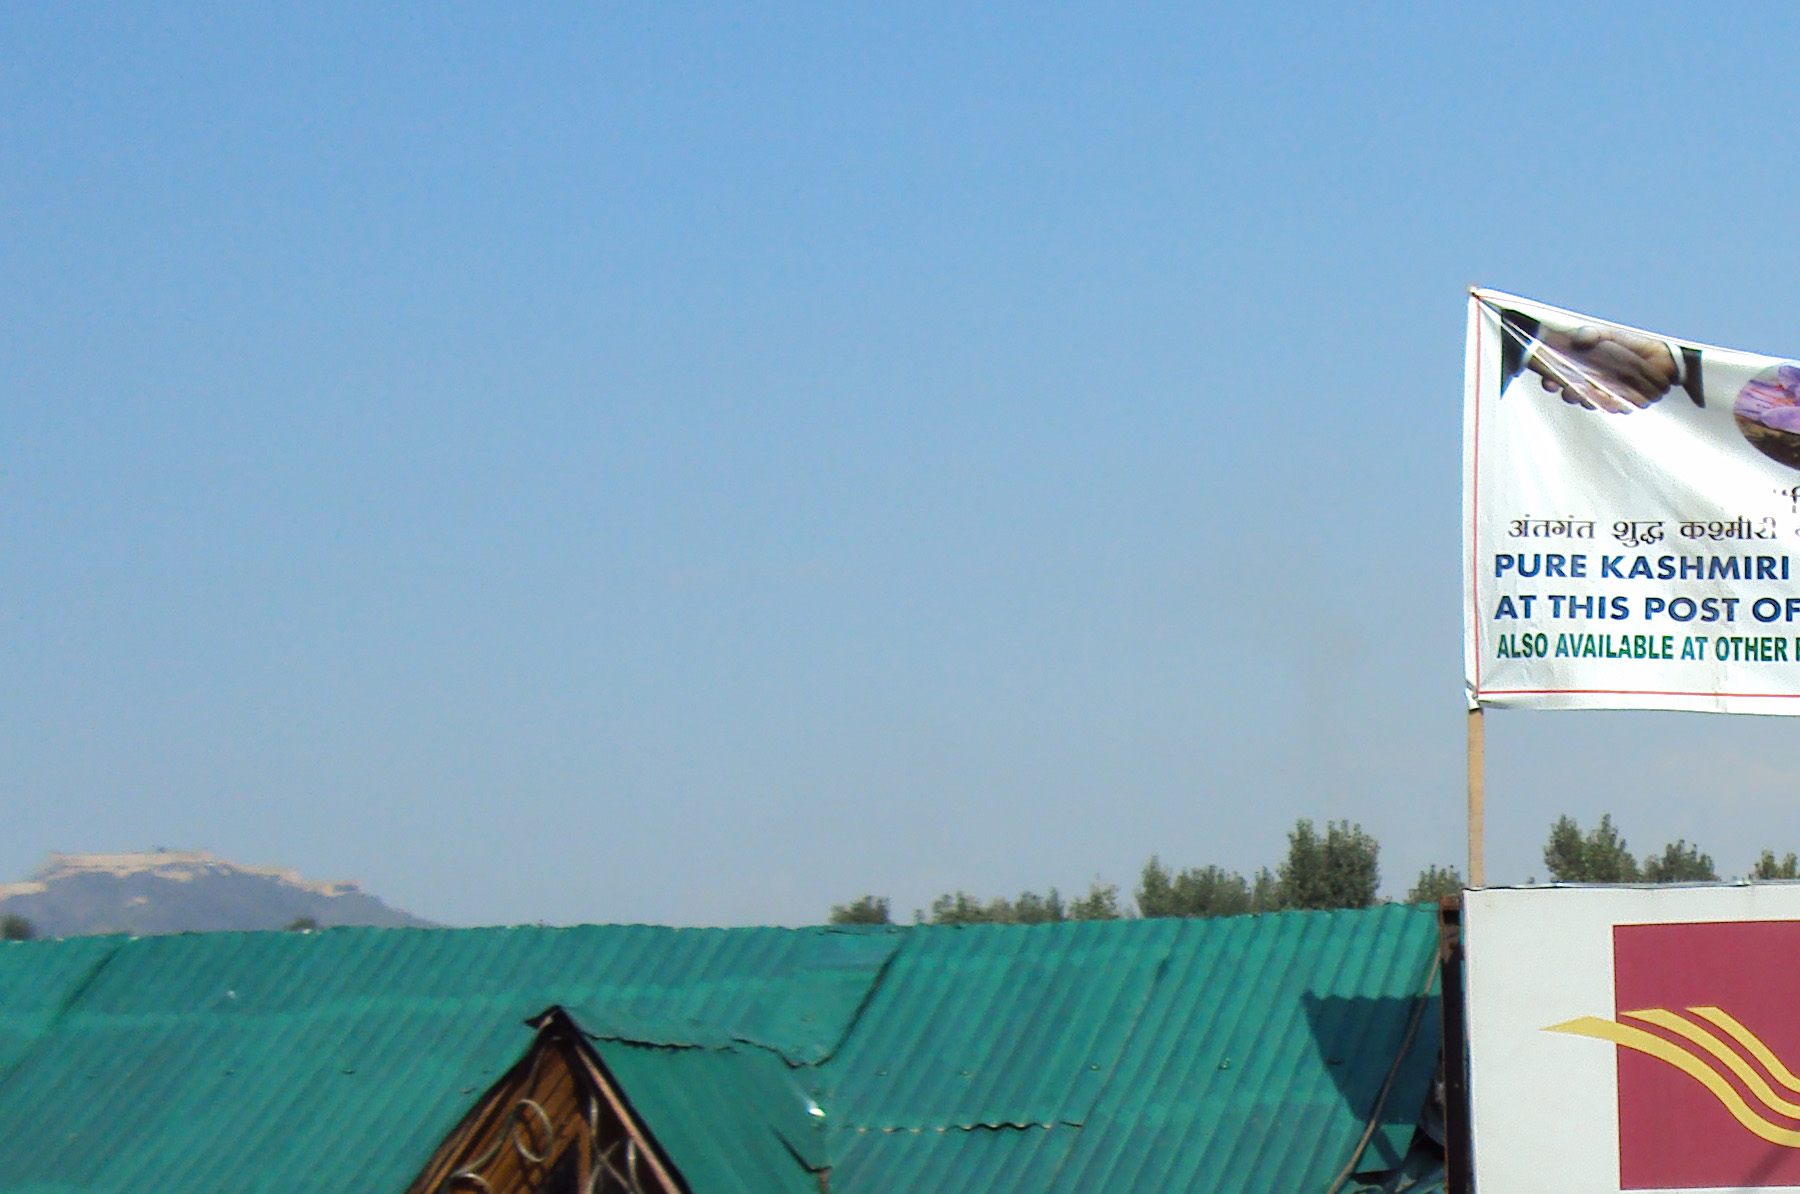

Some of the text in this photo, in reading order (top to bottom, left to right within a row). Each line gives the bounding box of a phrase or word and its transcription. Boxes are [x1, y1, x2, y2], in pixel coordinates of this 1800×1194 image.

[1495, 554, 1588, 578] PURE
[1602, 555, 1790, 581] KASHMIRI
[1494, 595, 1537, 620] AT
[1548, 595, 1630, 621] THIS
[1645, 596, 1740, 623] POST
[1497, 633, 1549, 660] ALSO
[1555, 633, 1674, 661] AVAILABLE
[1681, 636, 1708, 662] AT
[1715, 636, 1788, 663] OTHER
